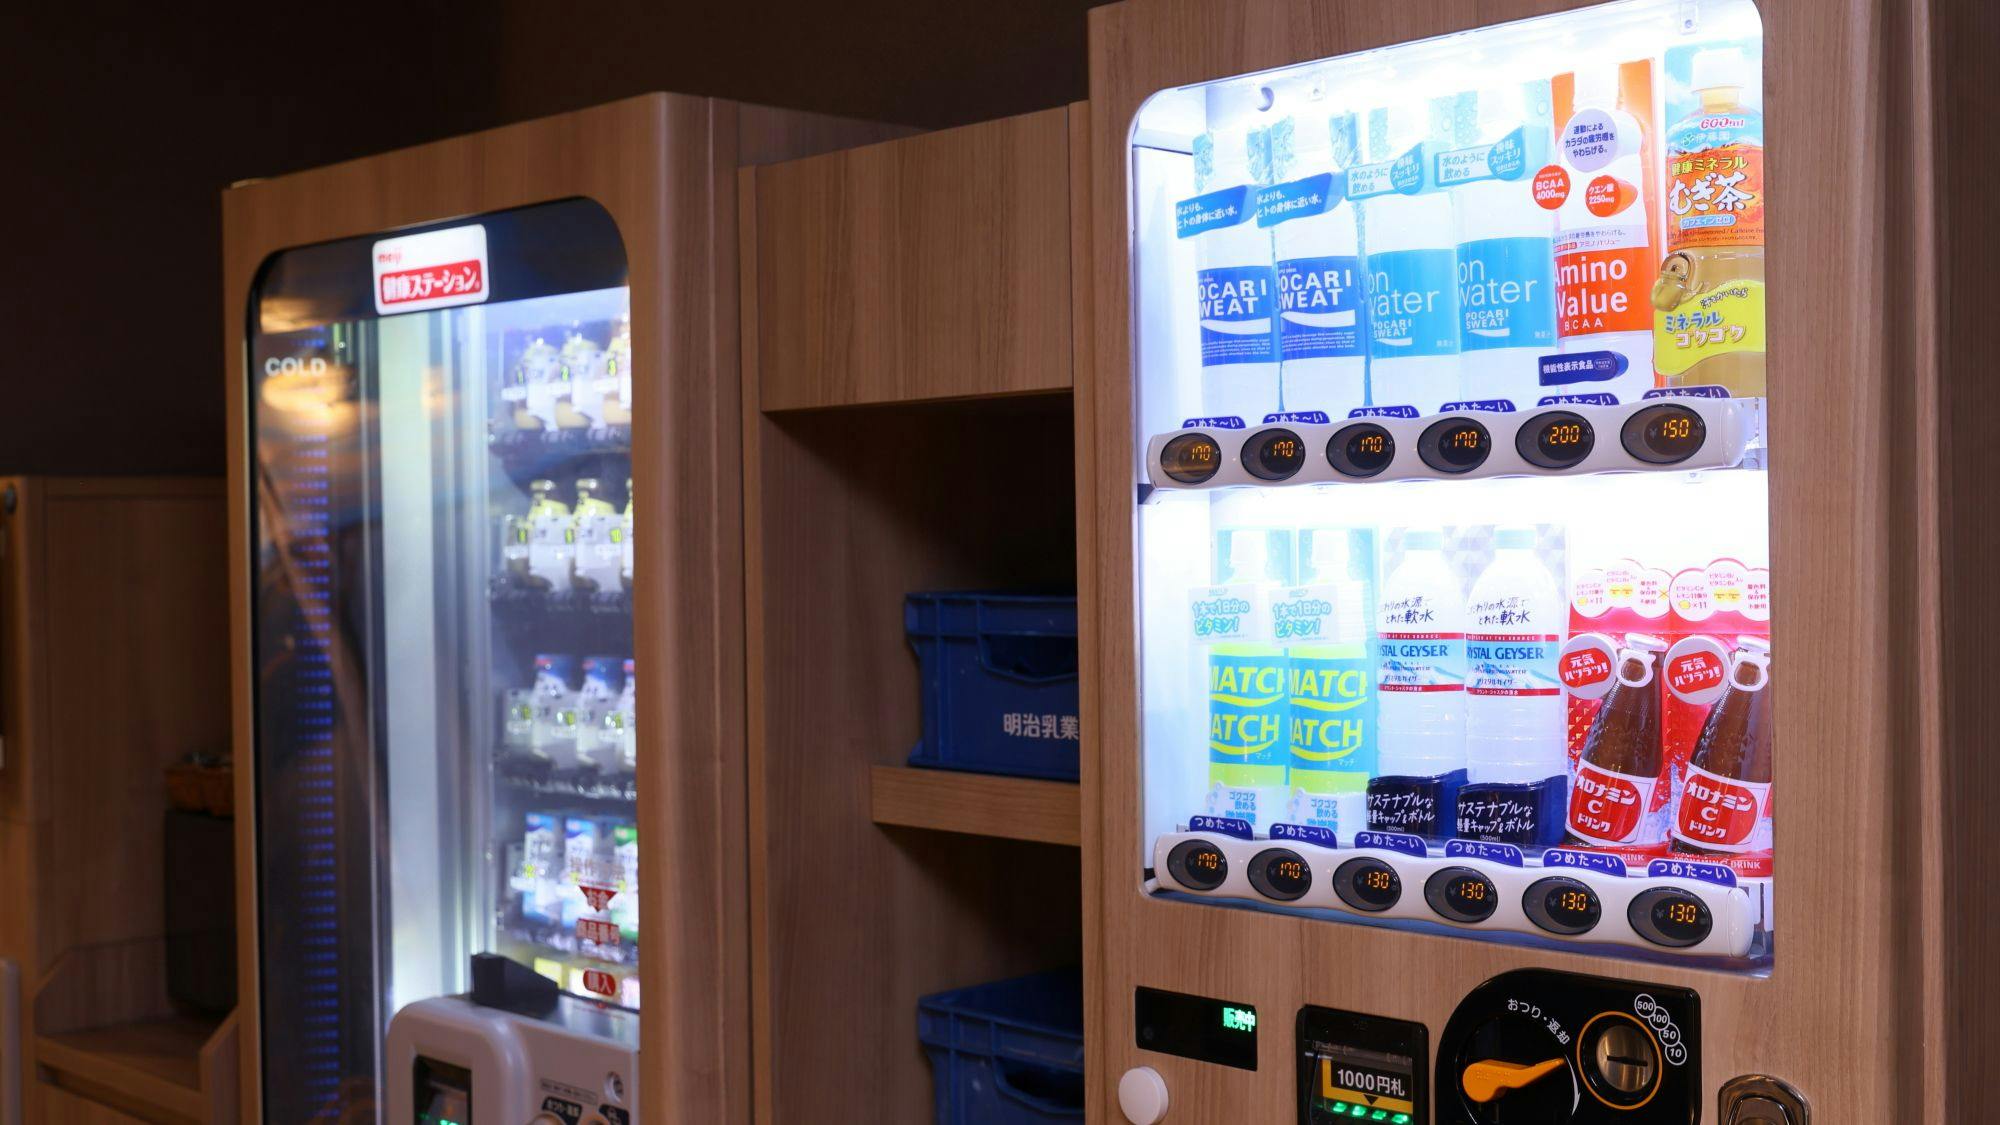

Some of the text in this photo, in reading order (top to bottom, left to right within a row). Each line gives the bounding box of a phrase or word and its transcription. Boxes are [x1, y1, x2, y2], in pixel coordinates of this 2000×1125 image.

[1573, 122, 1604, 136] 運動による
[1565, 132, 1615, 149] カラダの疲労感を
[1442, 151, 1485, 168] 水のように
[1573, 144, 1608, 158] やわらげる。
[1350, 166, 1388, 182] 水のように
[1444, 167, 1470, 181] 飲める
[1671, 156, 1749, 177] 健康ミネラル
[1352, 182, 1375, 195] 飲める
[1536, 179, 1564, 190] BCAA
[1669, 171, 1756, 215] むぎ茶
[1557, 287, 1628, 318] Value
[1465, 308, 1509, 321] POCARI
[1665, 311, 1723, 333] ミネラル
[1466, 317, 1504, 330] SWEAT
[1564, 317, 1604, 331] BCAA
[1675, 325, 1746, 348] ゴクゴク
[264, 357, 327, 376] COLD
[1550, 425, 1580, 444] 200
[1663, 419, 1689, 438] 150
[1360, 436, 1382, 453] 170
[1455, 431, 1478, 448] 170
[1191, 445, 1211, 461] 170
[1273, 441, 1294, 457] 170
[1192, 598, 1250, 618] 1本で1日分の
[1272, 600, 1333, 620] 1本で1日分の
[1385, 609, 1434, 625] とれた軟水
[1478, 609, 1530, 626] とれた軟水
[1400, 645, 1448, 657] GEYSER
[1495, 647, 1544, 660] GEYSER
[1570, 653, 1595, 667] 元気
[1680, 656, 1707, 671] 元気
[1003, 713, 1079, 740] 明治乳業
[1575, 775, 1636, 806] オロナミン
[1686, 781, 1753, 812] オロナミン
[1367, 793, 1434, 812] サステナブルな
[1458, 800, 1533, 818] サステナブルな
[1587, 800, 1603, 813] C
[1577, 813, 1611, 833] ドリンク
[1701, 807, 1718, 822] C
[1689, 819, 1727, 839] ドリンク
[1196, 853, 1217, 869] 170
[1731, 859, 1761, 870] DRINK
[1279, 862, 1301, 879] 170
[1367, 872, 1389, 889] 130
[1461, 882, 1484, 900] 130
[1561, 893, 1587, 911] 130
[1669, 903, 1696, 923] 130
[1637, 1000, 1654, 1012] 500
[1223, 1007, 1256, 1032] 販売中
[1507, 998, 1570, 1046] おつり・返却
[1653, 1013, 1667, 1025] 100
[1663, 1029, 1677, 1042] 50
[1669, 1047, 1682, 1059] 10
[1337, 1069, 1406, 1097] 1000円札
